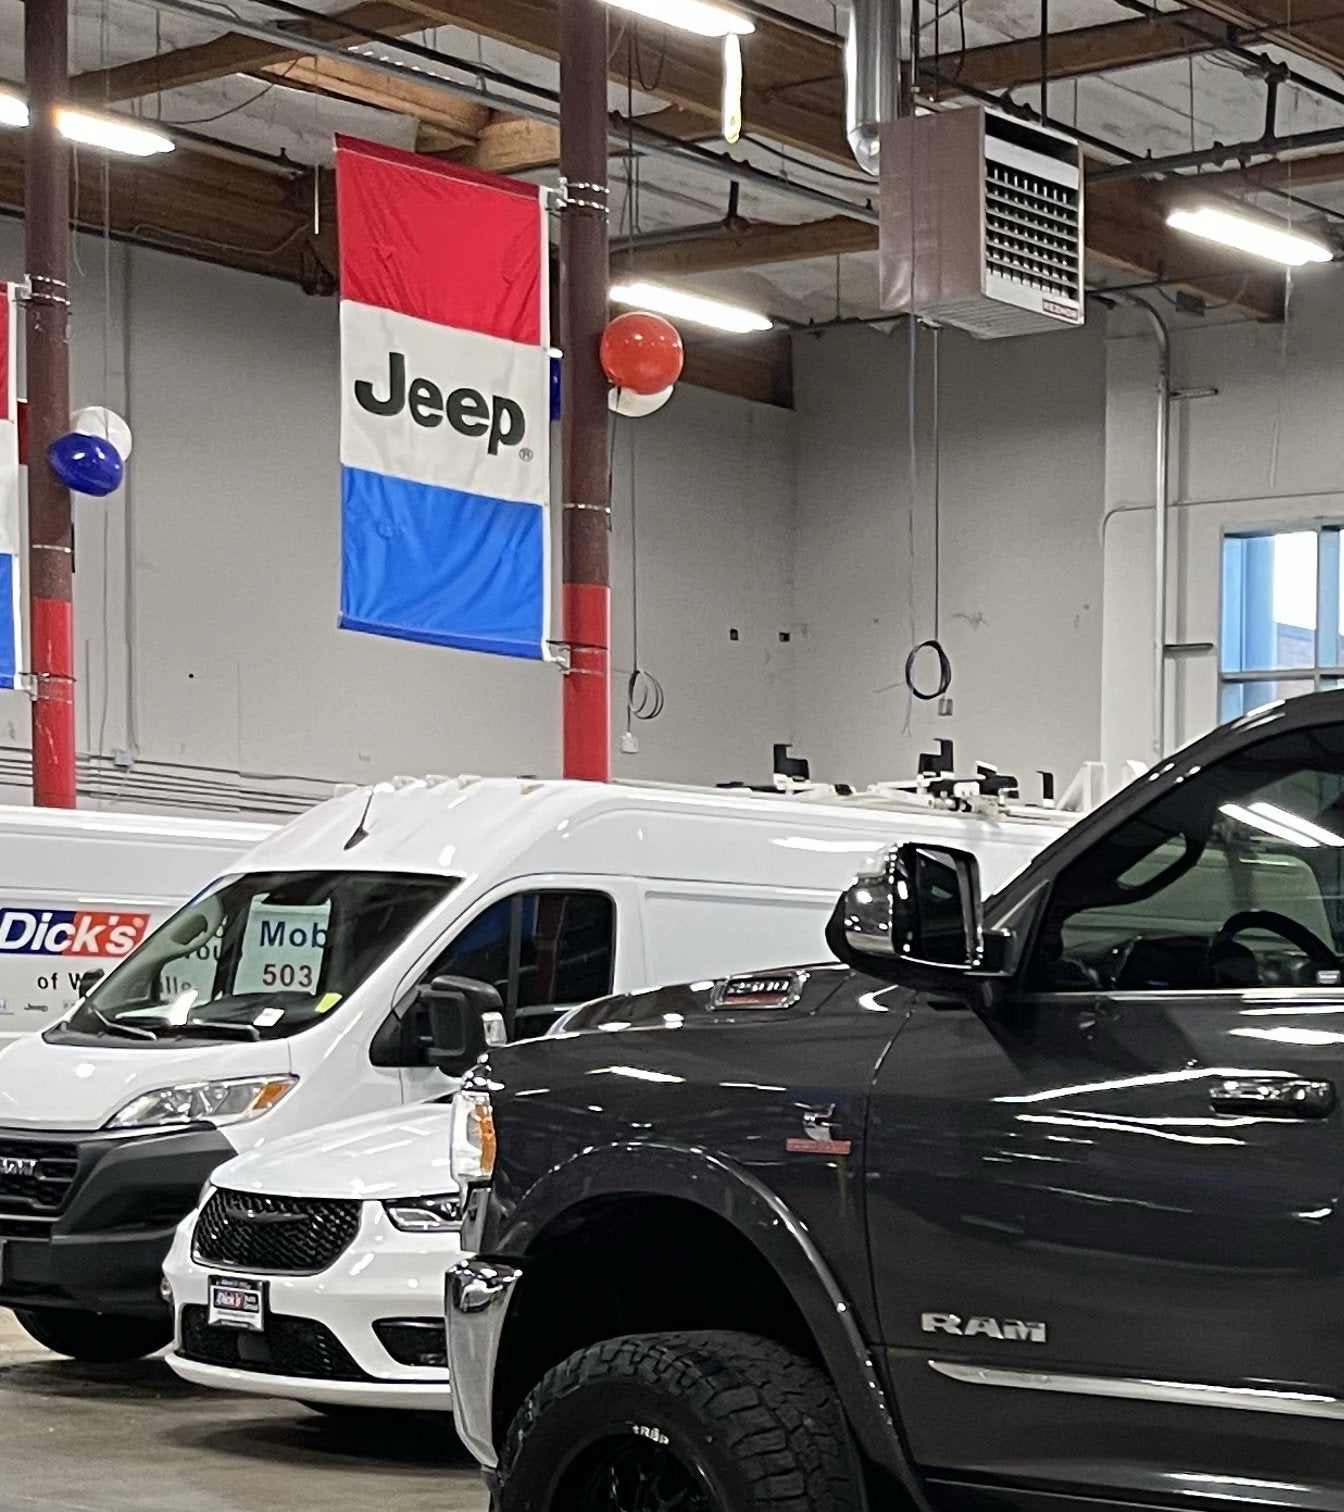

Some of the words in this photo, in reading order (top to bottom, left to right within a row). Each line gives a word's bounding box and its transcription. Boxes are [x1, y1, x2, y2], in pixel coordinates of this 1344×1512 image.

[355, 352, 525, 455] Jeep
[0, 912, 136, 954] Dick's
[38, 973, 58, 990] of
[263, 964, 312, 987] 503
[921, 1312, 1046, 1342] RAM
